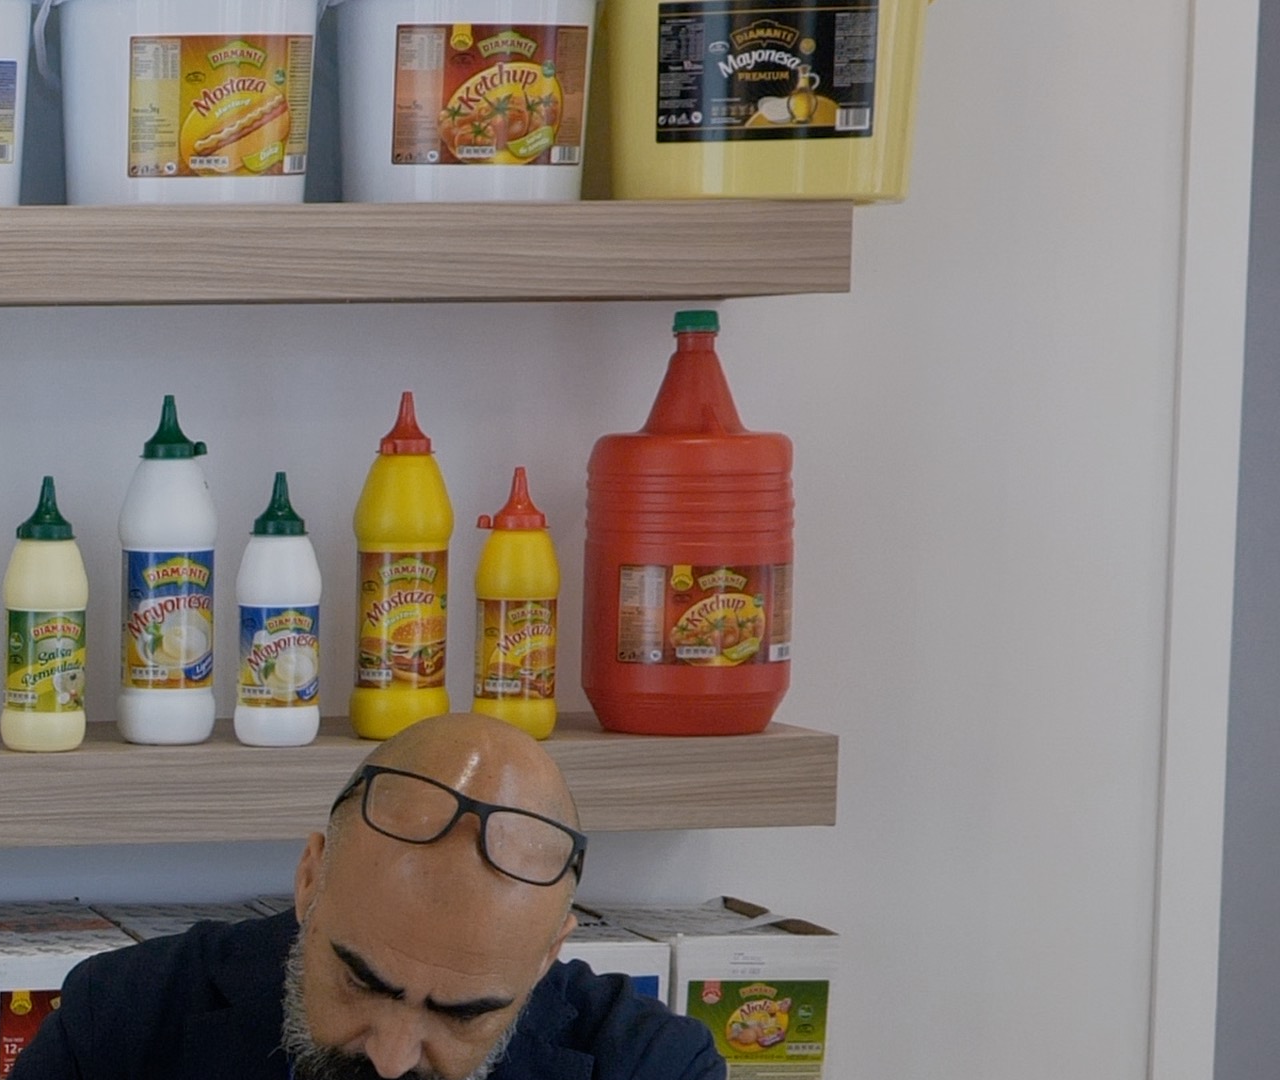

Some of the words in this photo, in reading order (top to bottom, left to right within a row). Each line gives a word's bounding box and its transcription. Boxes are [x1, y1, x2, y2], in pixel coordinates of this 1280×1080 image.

[482, 40, 533, 53] DIAMANTE
[736, 28, 793, 42] DIAMANTE
[211, 50, 262, 63] DIAMANTE
[718, 49, 801, 78] Mayonesa
[458, 63, 537, 110] Ketchup
[738, 71, 789, 81] PREMIUM
[192, 77, 266, 117] Mostaza
[148, 567, 207, 582] DIAMANTE
[382, 565, 435, 578] DIAMANTE
[128, 595, 211, 639] Mayonesa
[366, 590, 434, 628] Mostaza
[686, 595, 746, 629] Ketchup
[247, 634, 317, 672] Mayonesa
[497, 624, 553, 656] Mostaza
[38, 648, 72, 666] Salsa
